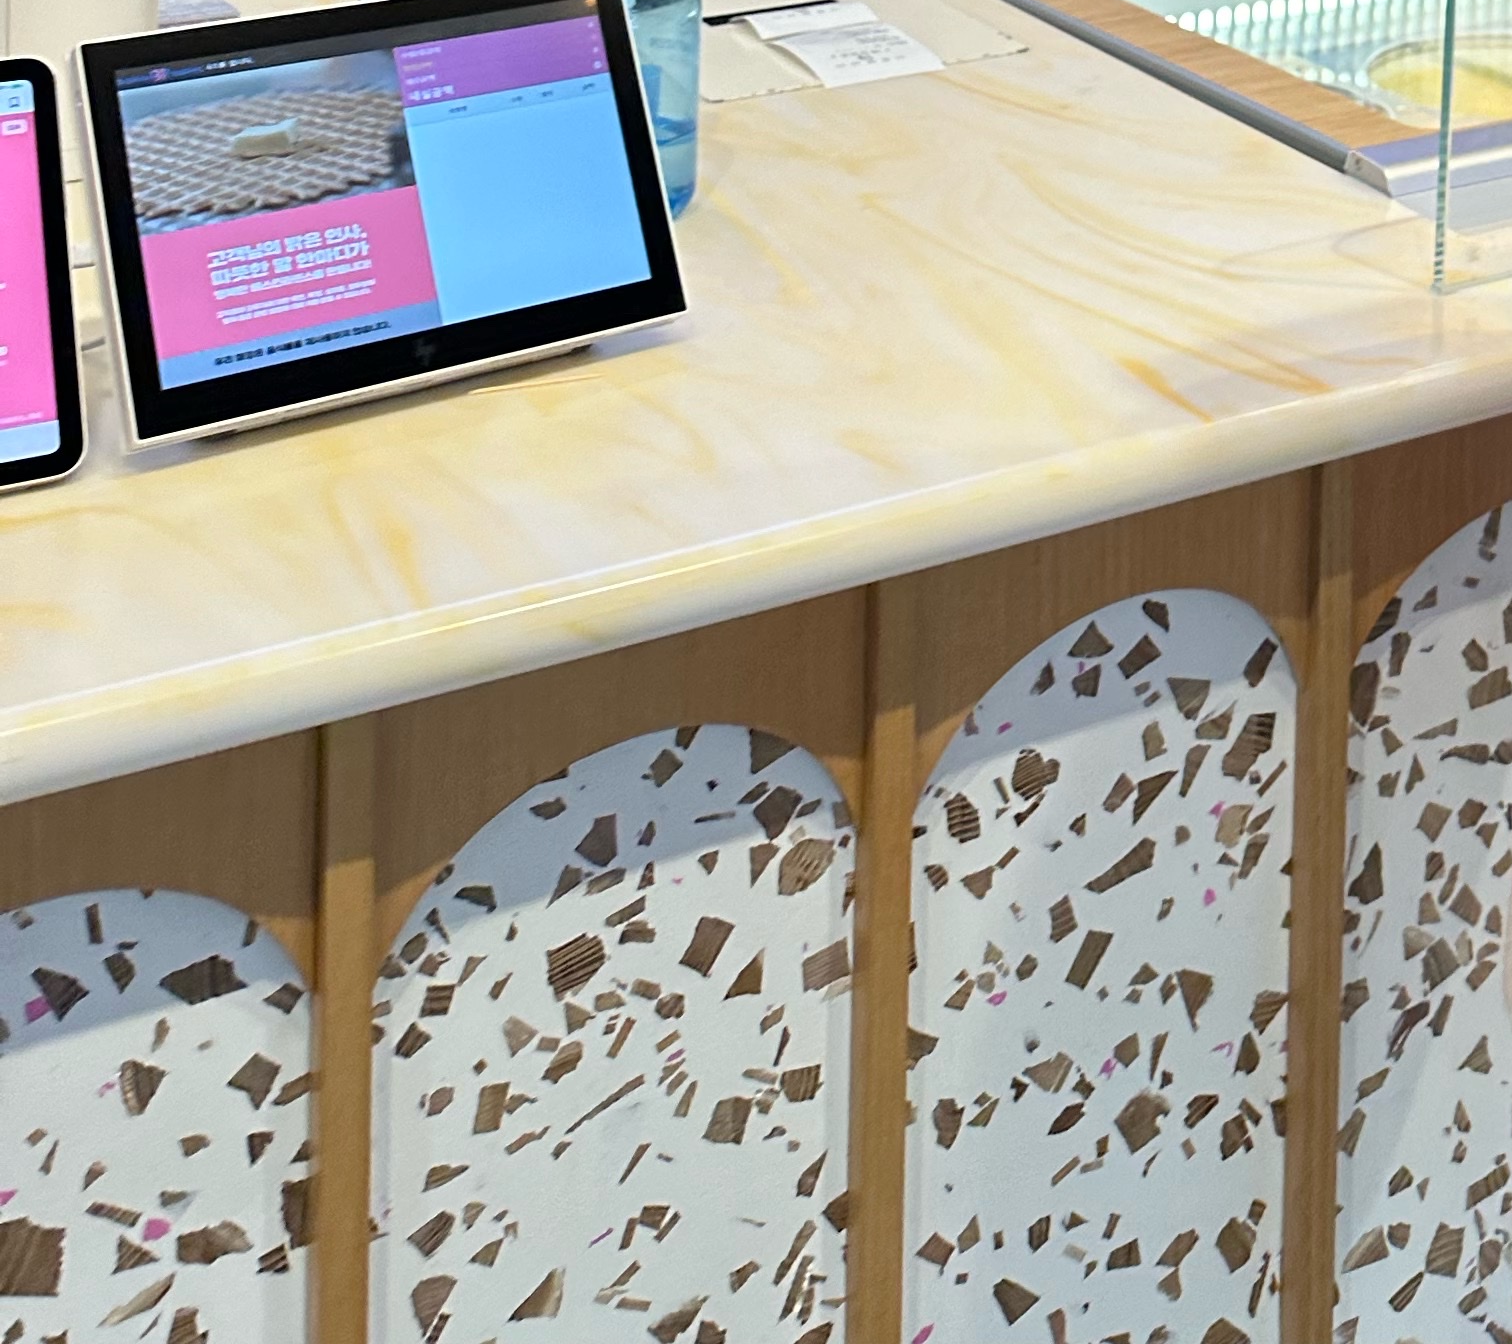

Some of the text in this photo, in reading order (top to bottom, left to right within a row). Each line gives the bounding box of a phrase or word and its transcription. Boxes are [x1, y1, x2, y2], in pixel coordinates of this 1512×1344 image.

[207, 239, 282, 269] 고객님의
[284, 231, 323, 253] 밝은
[210, 260, 270, 286] 따뜻한
[295, 240, 370, 269] 한마디가
